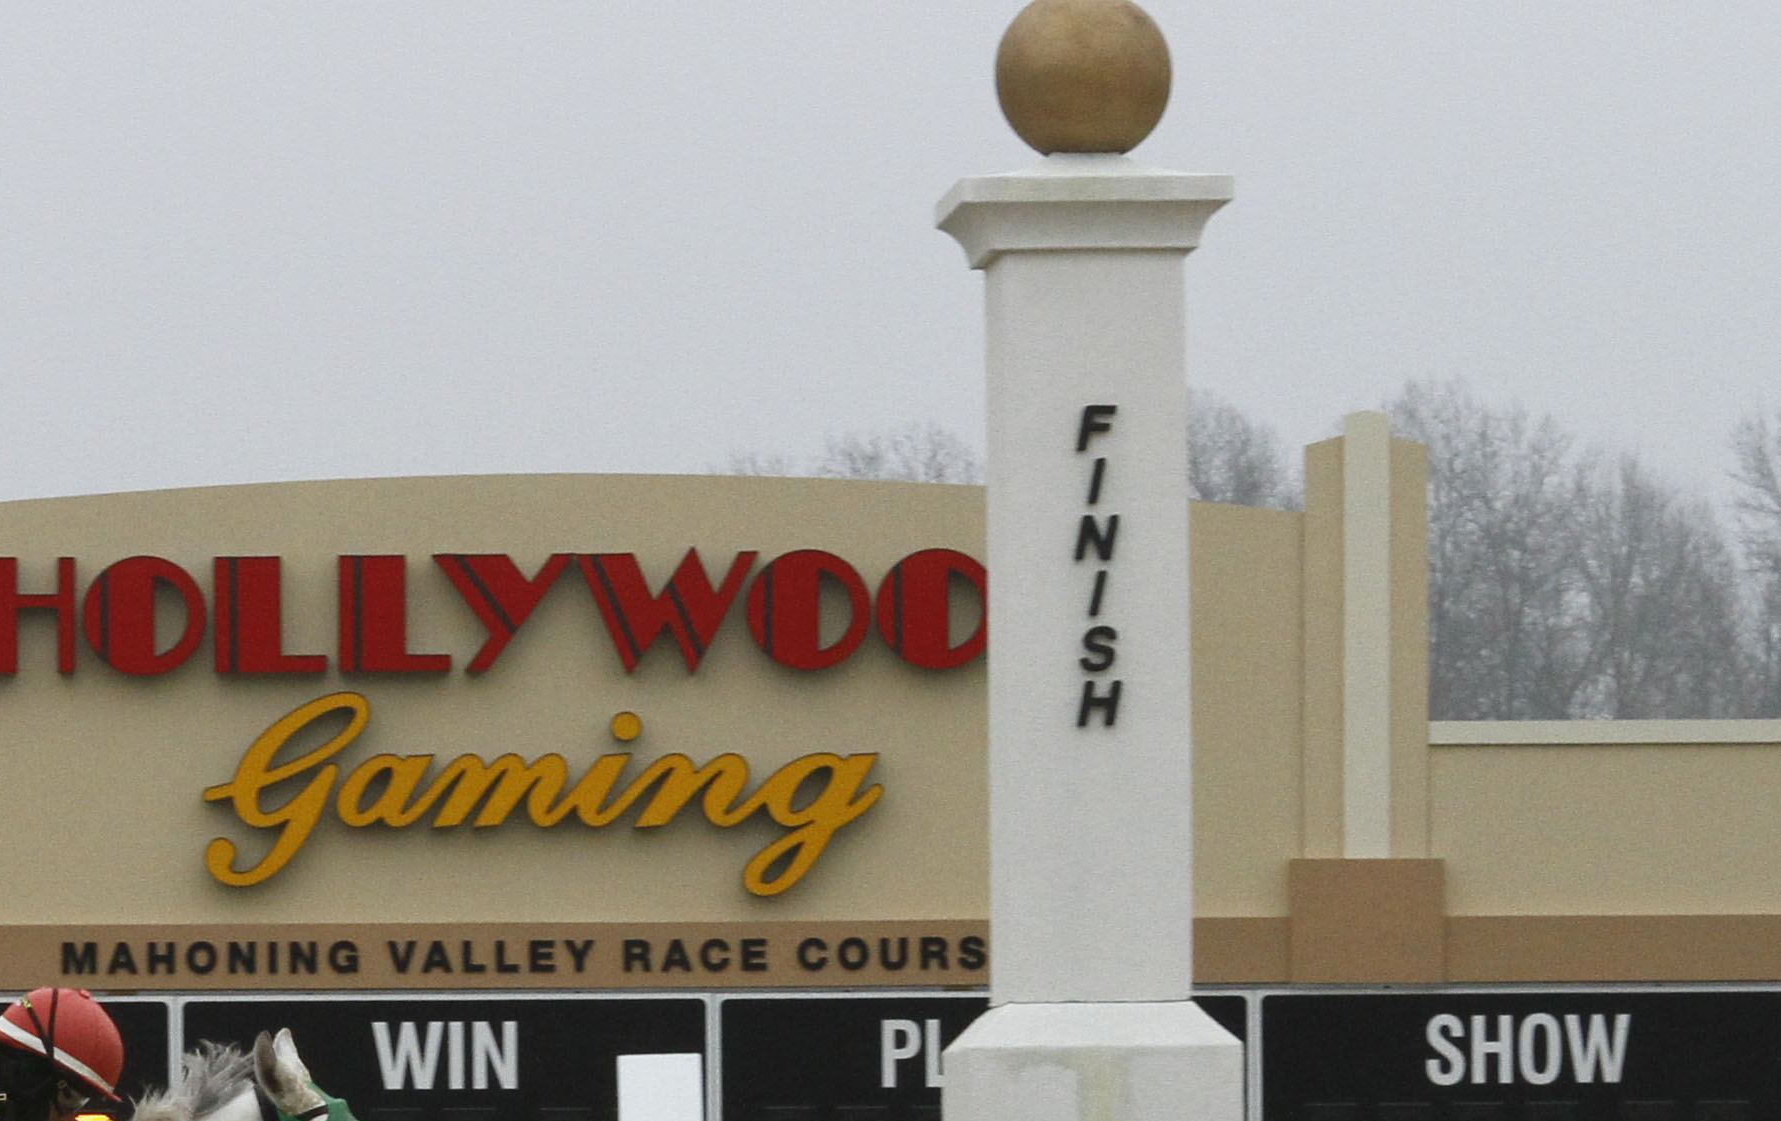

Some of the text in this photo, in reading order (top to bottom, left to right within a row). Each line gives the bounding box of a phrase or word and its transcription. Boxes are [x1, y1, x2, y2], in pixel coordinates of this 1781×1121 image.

[1075, 404, 1122, 728] FINISH
[203, 692, 883, 898] Gaming
[60, 940, 361, 975] MAHONING
[386, 939, 595, 974] VALLEY
[622, 938, 769, 973] RACE
[371, 1020, 519, 1091] WIN
[1425, 1012, 1631, 1086] SHOW
